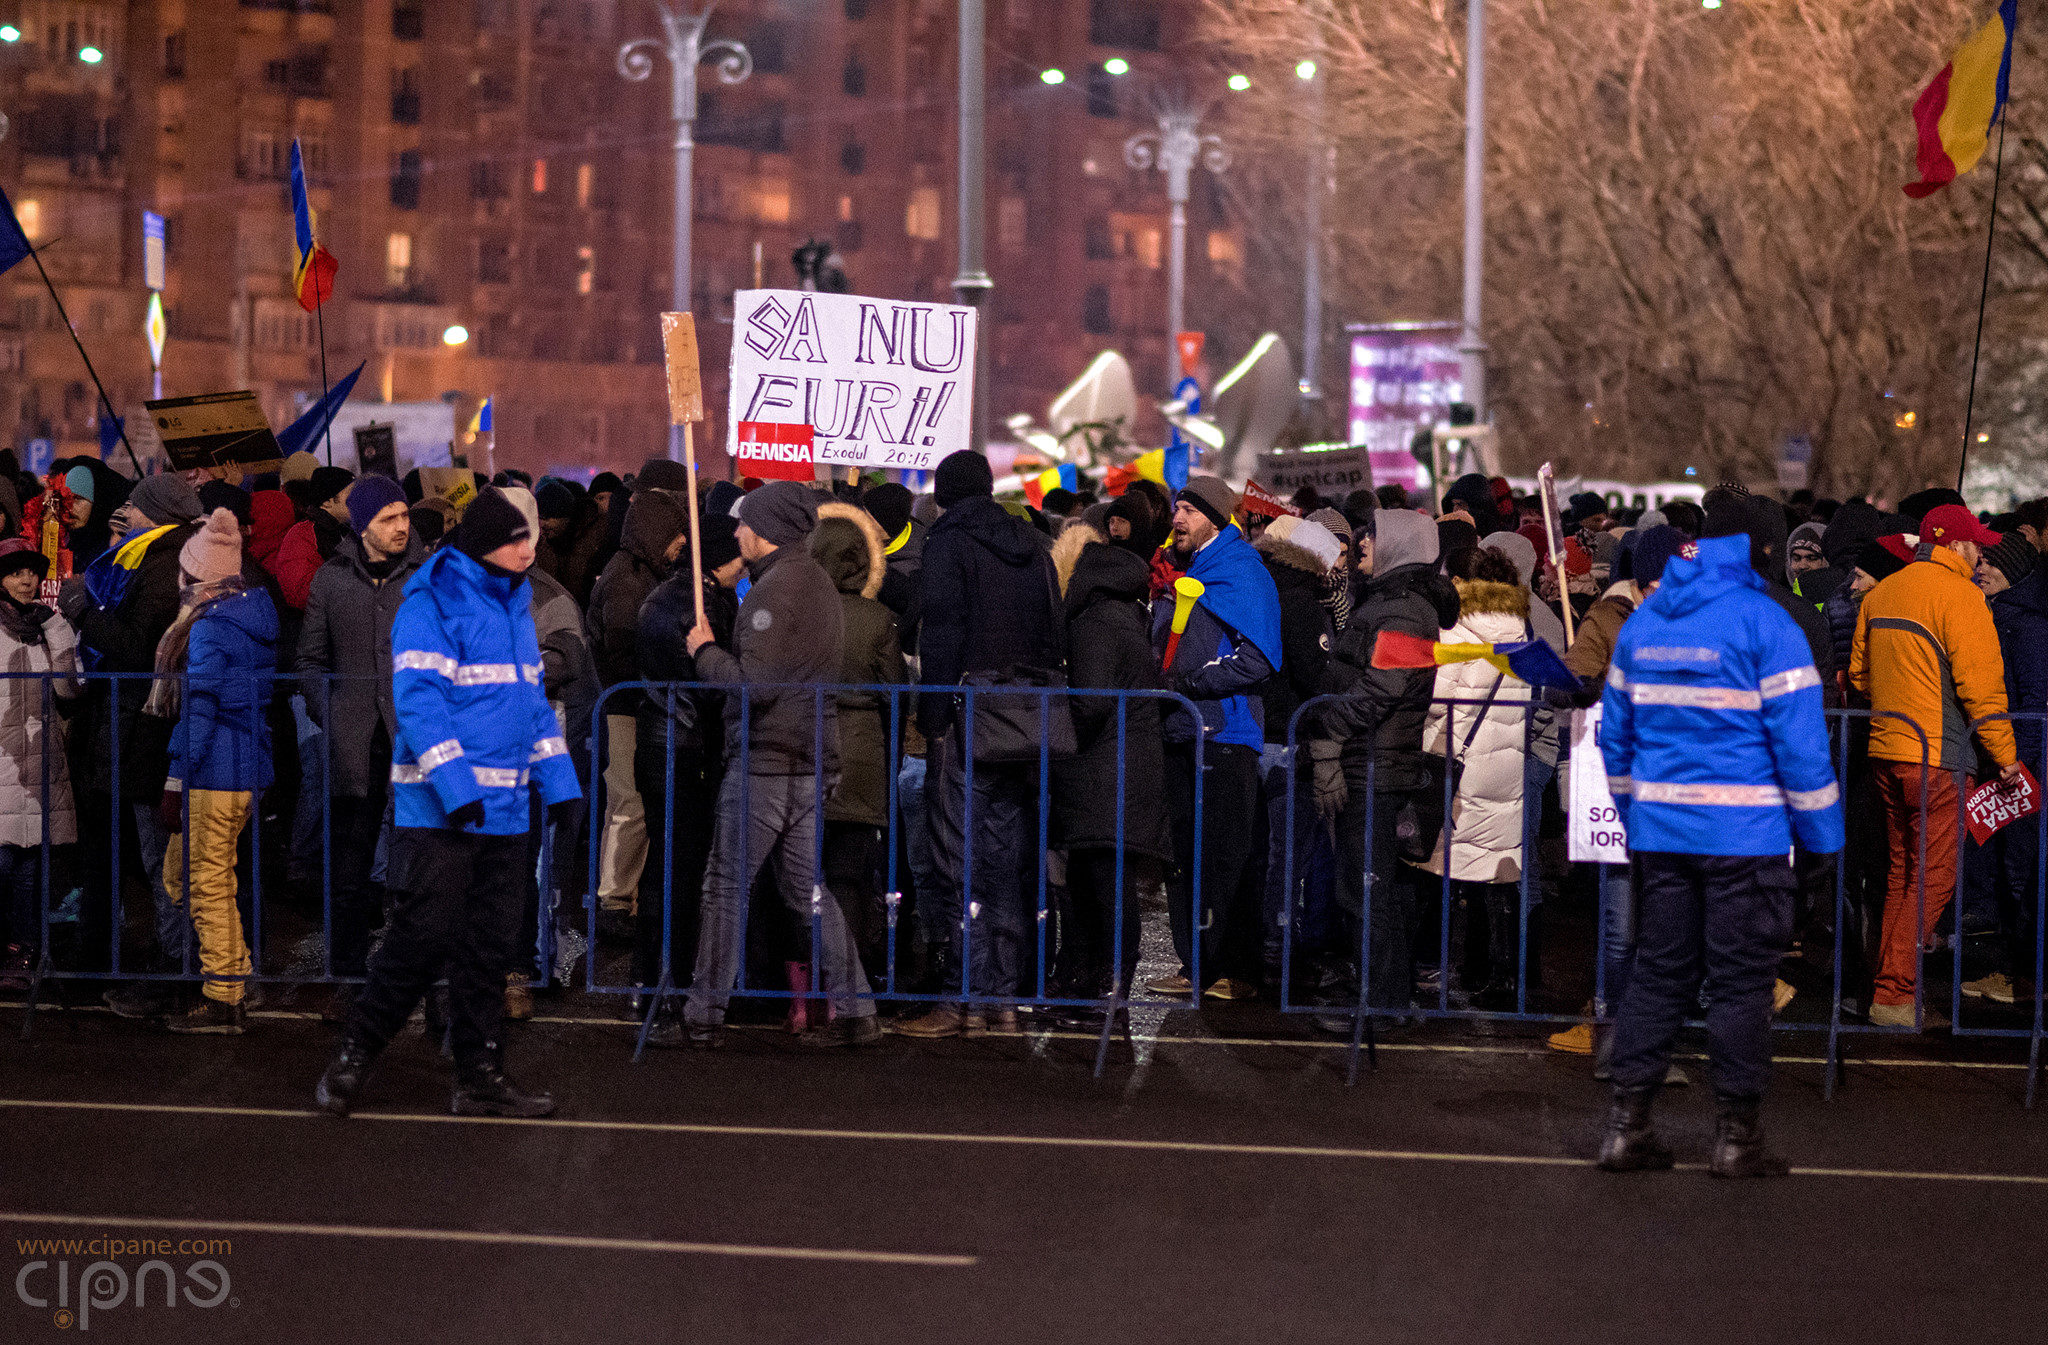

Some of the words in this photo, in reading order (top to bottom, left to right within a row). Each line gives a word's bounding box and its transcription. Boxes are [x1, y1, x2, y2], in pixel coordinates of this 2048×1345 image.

[744, 293, 828, 364] SĂ
[855, 303, 969, 374] NU
[738, 441, 813, 464] DEMISIA
[821, 441, 869, 461] Exodul
[884, 448, 932, 467] 20:15
[1966, 782, 2001, 812] UVERN
[1590, 830, 1625, 847] IOR
